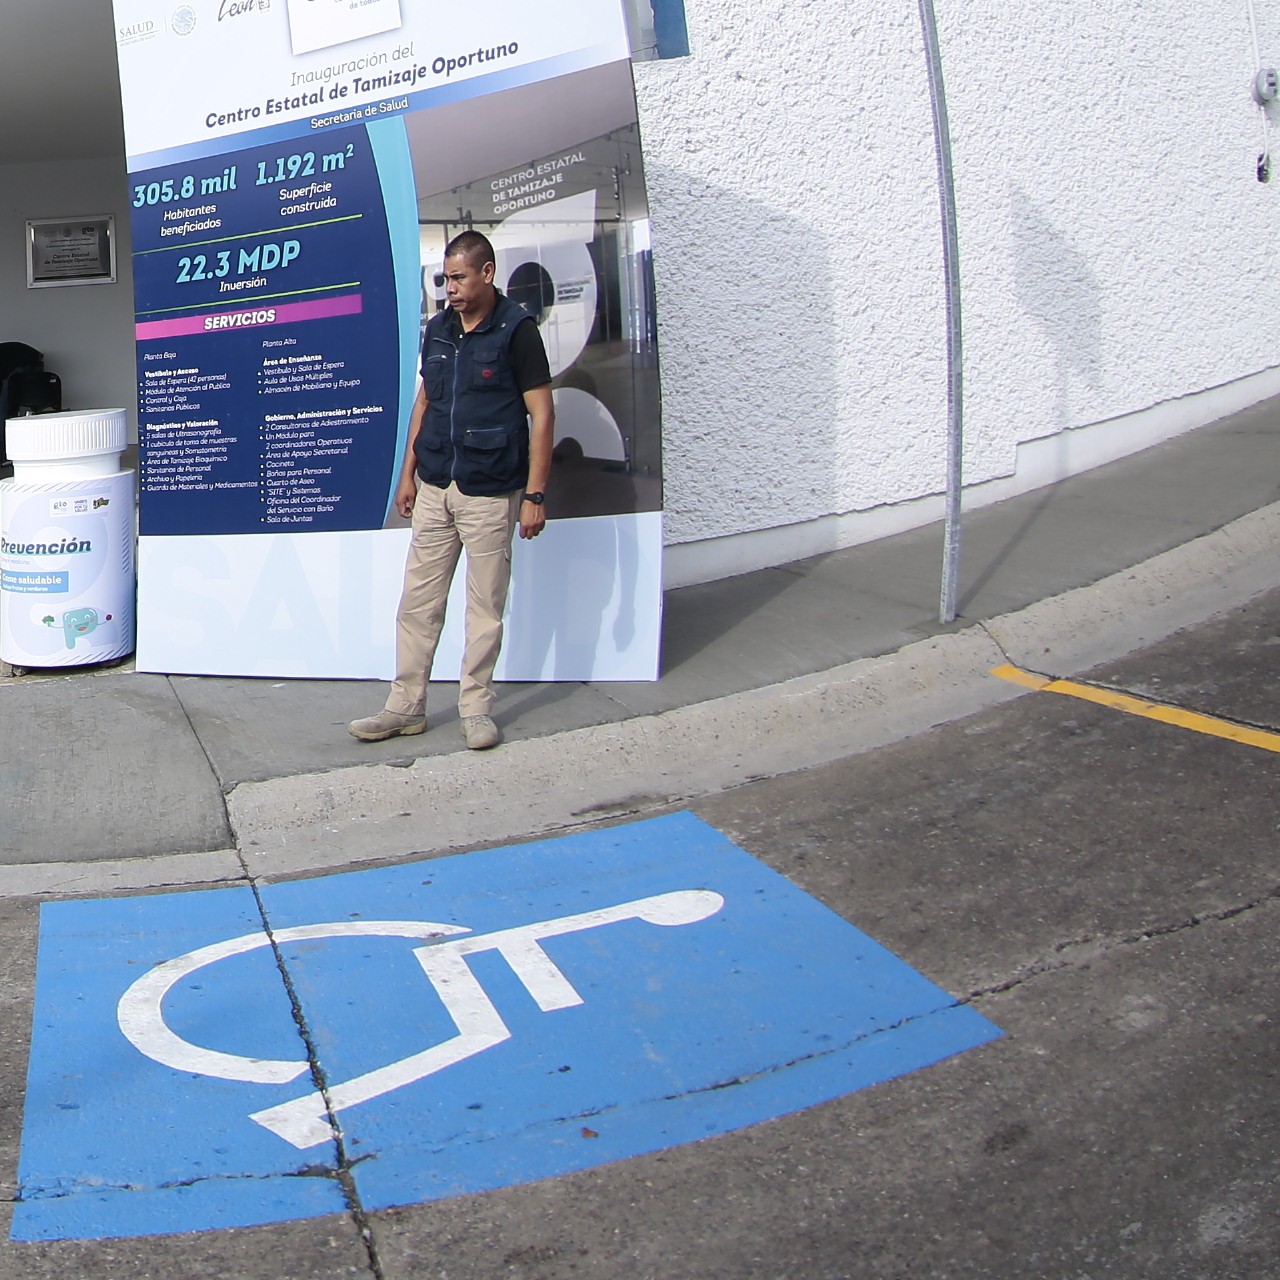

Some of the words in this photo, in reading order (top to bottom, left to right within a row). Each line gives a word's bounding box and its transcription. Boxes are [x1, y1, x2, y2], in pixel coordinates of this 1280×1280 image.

[120, 20, 154, 38] SALUD
[291, 52, 388, 86] Inauguración
[392, 41, 414, 61] del
[205, 107, 260, 128] Centro
[266, 86, 324, 115] Estatal
[329, 83, 348, 99] de
[353, 64, 426, 94] Tamizaje
[432, 41, 518, 77] Oportuno
[364, 106, 377, 116] de
[379, 97, 408, 113] Salud
[255, 151, 315, 186] 1.192
[491, 169, 534, 191] CENTRO
[537, 152, 586, 175] ESTATAL
[132, 175, 195, 208] 305.8
[200, 166, 237, 195] mil
[279, 181, 332, 200] Superficie
[492, 191, 506, 203] DE
[507, 173, 563, 197] TAMIZAJE
[280, 196, 337, 216] construida
[493, 189, 556, 214] OPORTUNO
[164, 204, 217, 221] Habitantes
[82, 226, 94, 234] gto
[160, 218, 222, 236] beneficiados
[176, 250, 231, 284] 22.3
[237, 239, 301, 275] MDP
[204, 309, 276, 330] SERVICIOS
[339, 379, 360, 388] Equipo
[353, 406, 383, 414] Servicios
[300, 431, 314, 439] para
[291, 450, 312, 458] Apoyo
[287, 469, 302, 477] para
[301, 495, 341, 503] Coordinador
[267, 506, 276, 514] del
[2, 537, 91, 554] Prevención
[2, 573, 16, 581] Come
[18, 576, 62, 584] saludable
